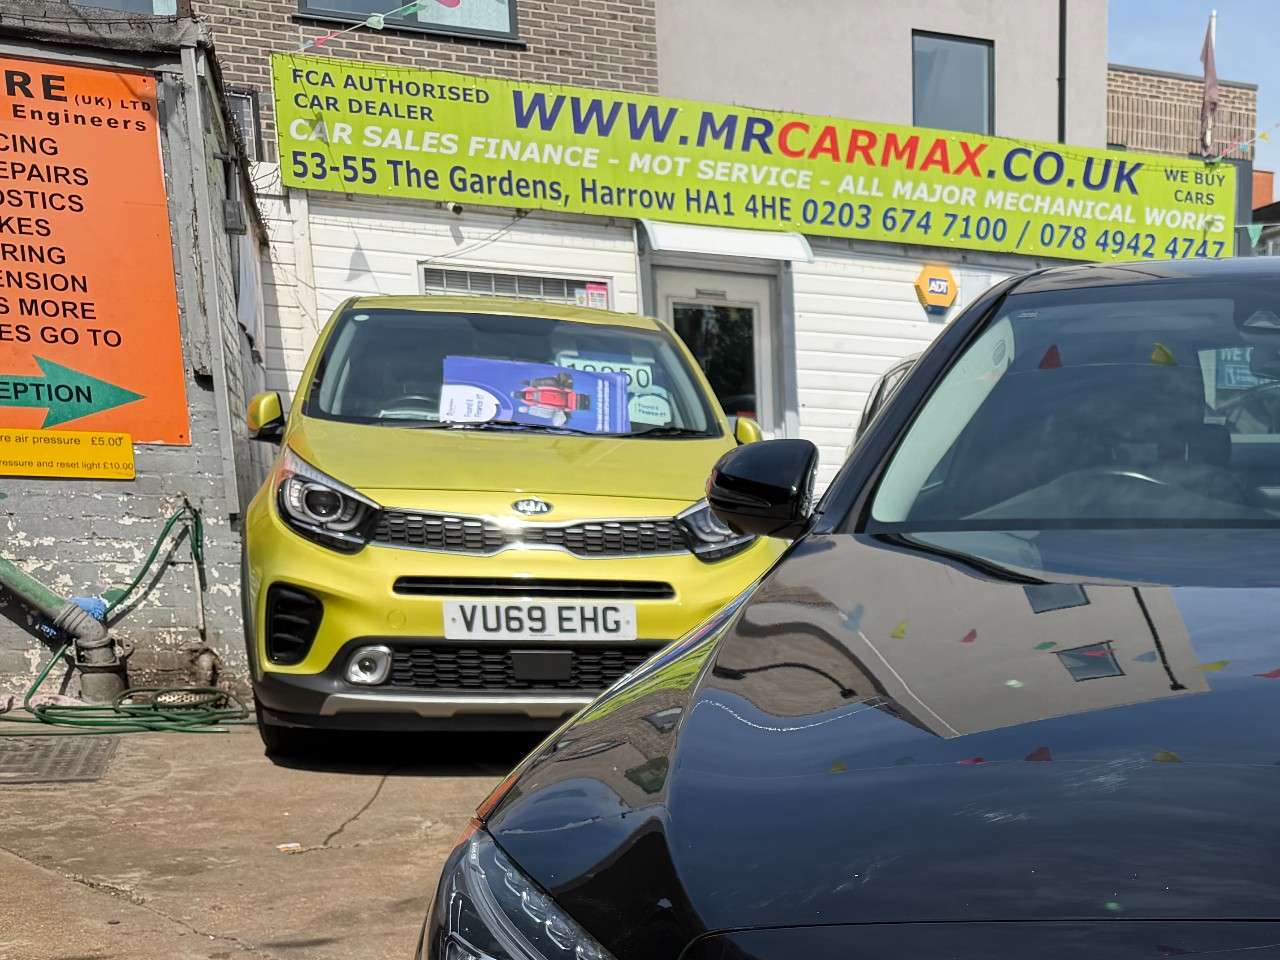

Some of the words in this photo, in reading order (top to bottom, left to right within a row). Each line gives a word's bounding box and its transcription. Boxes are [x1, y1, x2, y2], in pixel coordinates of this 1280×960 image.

[5, 70, 67, 102] RE
[292, 68, 336, 88] FCA
[343, 74, 490, 104] AUTHORISED
[74, 94, 112, 110] (UK)
[120, 99, 151, 112] LTD
[294, 93, 340, 112] CAR
[348, 98, 435, 122] DEALER
[12, 104, 147, 132] Engineers
[512, 89, 1145, 196] WWW.MRCARMAX.CO.UK
[289, 118, 353, 145] CAR
[363, 125, 459, 155] SALES
[468, 135, 600, 168] FINANCE
[629, 152, 691, 177] MOT
[697, 159, 813, 190] SERVICE
[838, 175, 884, 198] ALL
[892, 180, 977, 207] MAJOR
[984, 189, 1137, 225] MECHANICAL
[1144, 207, 1227, 234] WORKS
[1164, 168, 1190, 184] WE
[1194, 170, 1227, 188] BUY
[0, 189, 84, 212] STICS
[292, 150, 378, 185] 53-55
[387, 159, 440, 190] The
[449, 165, 570, 208] Gardens,
[580, 177, 676, 211] Harrow
[685, 187, 735, 217] HA1
[744, 194, 792, 222] 4HE
[802, 198, 872, 230] 0203
[882, 206, 932, 236] 674
[942, 212, 1008, 242] 7100
[1040, 222, 1087, 251] 078
[1095, 229, 1156, 259] 4942
[1164, 236, 1226, 259] 4747
[1174, 189, 1216, 206] CARS
[1, 243, 66, 265] RING
[929, 279, 947, 294] ADT
[19, 298, 97, 320] MORE
[0, 323, 31, 342] ES
[40, 326, 80, 345] GO
[87, 329, 122, 348] TO
[0, 381, 93, 404] EPTION
[15, 434, 29, 444] air
[32, 436, 81, 446] pressure
[37, 459, 54, 468] and
[57, 460, 80, 469] reset
[82, 461, 102, 471] light
[517, 500, 548, 512] KIA
[459, 604, 547, 633] VU69
[558, 605, 622, 634] EHG
